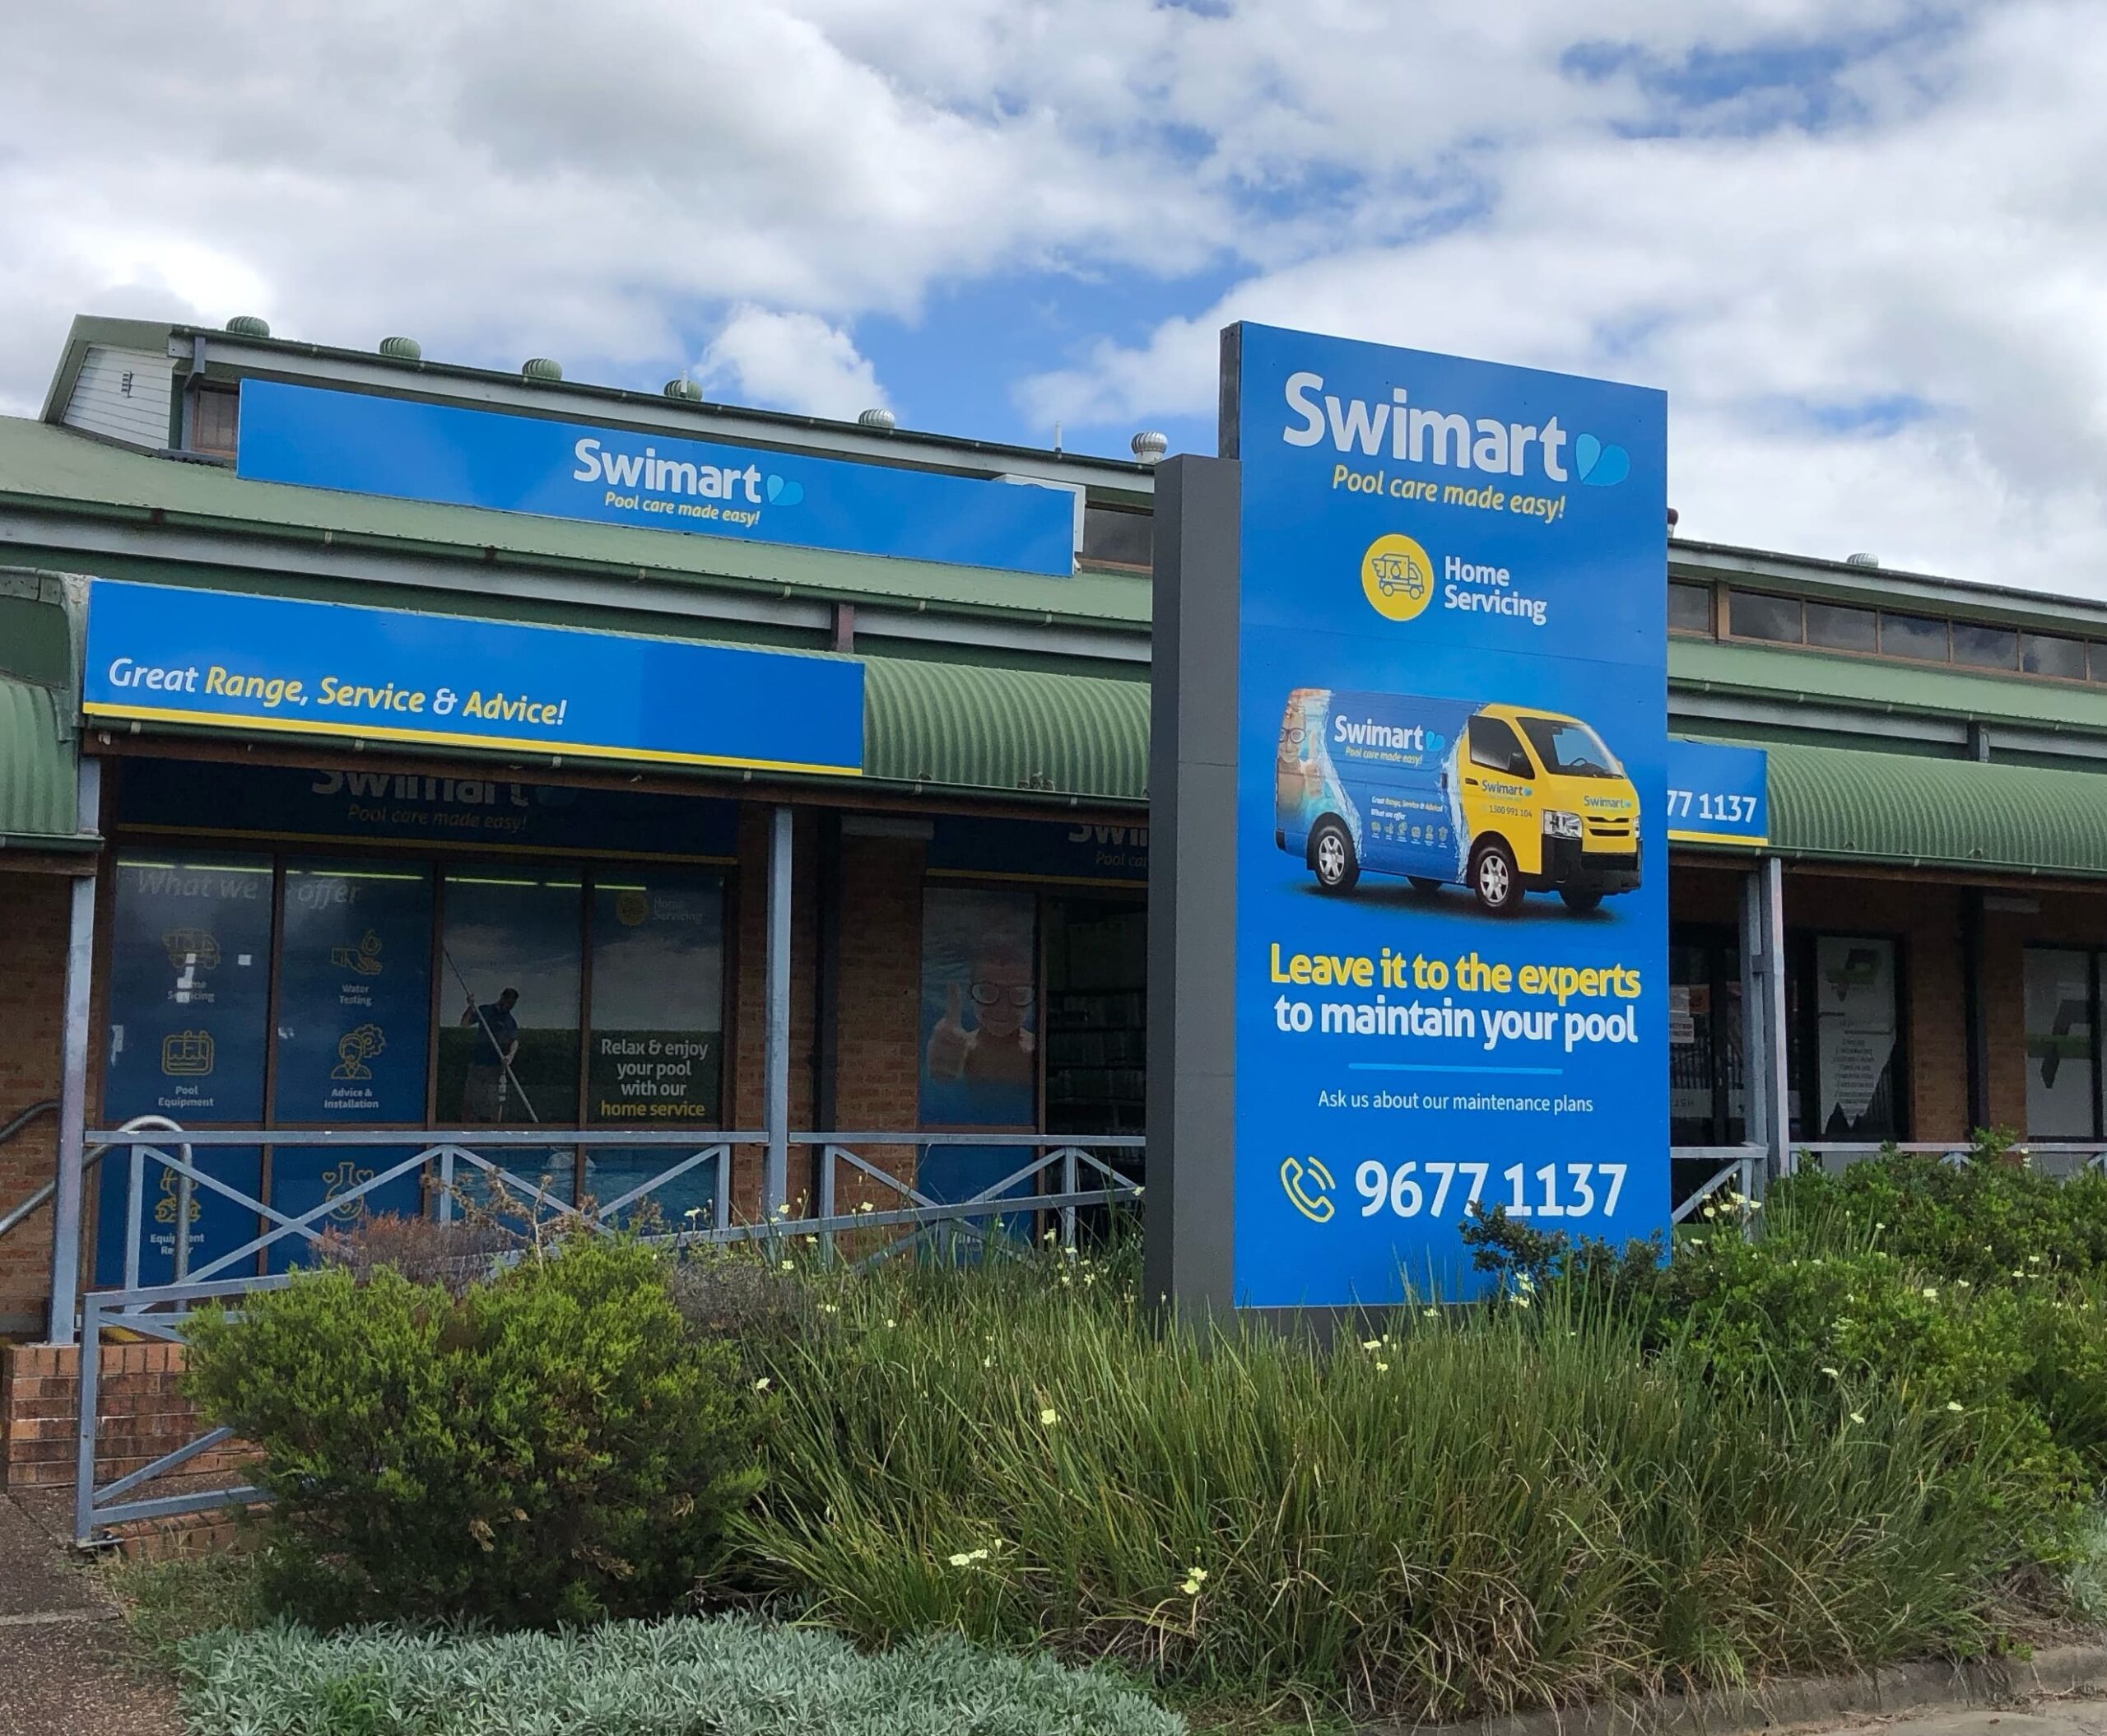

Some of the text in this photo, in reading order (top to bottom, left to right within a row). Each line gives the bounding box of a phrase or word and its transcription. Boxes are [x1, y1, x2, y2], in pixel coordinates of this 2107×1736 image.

[1282, 371, 1568, 482] Swimart
[574, 439, 761, 503] Swimart
[1333, 464, 1565, 524] Pool care made easy!
[605, 491, 760, 528] Pool care made easy!
[1444, 556, 1509, 588] Home
[1444, 584, 1547, 626] Servicing
[109, 658, 567, 725] Great Range, Service & Advice!
[1334, 715, 1423, 751] Swimart
[1346, 746, 1361, 757] Pool
[1363, 750, 1379, 759] care
[1380, 751, 1402, 762] made
[1481, 780, 1523, 796] Swimart
[1584, 795, 1625, 808] Swimart
[1699, 793, 1757, 823] 1137
[348, 803, 386, 822] Pool
[392, 808, 428, 824] care
[433, 811, 478, 828] made
[220, 878, 258, 899] we
[297, 878, 361, 910] offer
[1271, 942, 1641, 1006] Leave it to the experts
[167, 990, 216, 1003] Seicing
[342, 984, 370, 994] Water
[338, 995, 372, 1007] Testing
[1274, 994, 1638, 1053] to maintain your pool
[601, 1038, 709, 1059] Relax & enjoy
[617, 1060, 691, 1080] your pool
[174, 1086, 198, 1095] Pool
[331, 1087, 373, 1097] Advice &
[621, 1080, 687, 1096] with our
[158, 1097, 215, 1108] Equipment
[324, 1099, 379, 1109] Installation
[601, 1100, 705, 1117] home service
[1318, 1089, 1593, 1115] Ask us about our maintenance plans
[1356, 1160, 1627, 1217] 9677 1137
[150, 1232, 205, 1245] Equient
